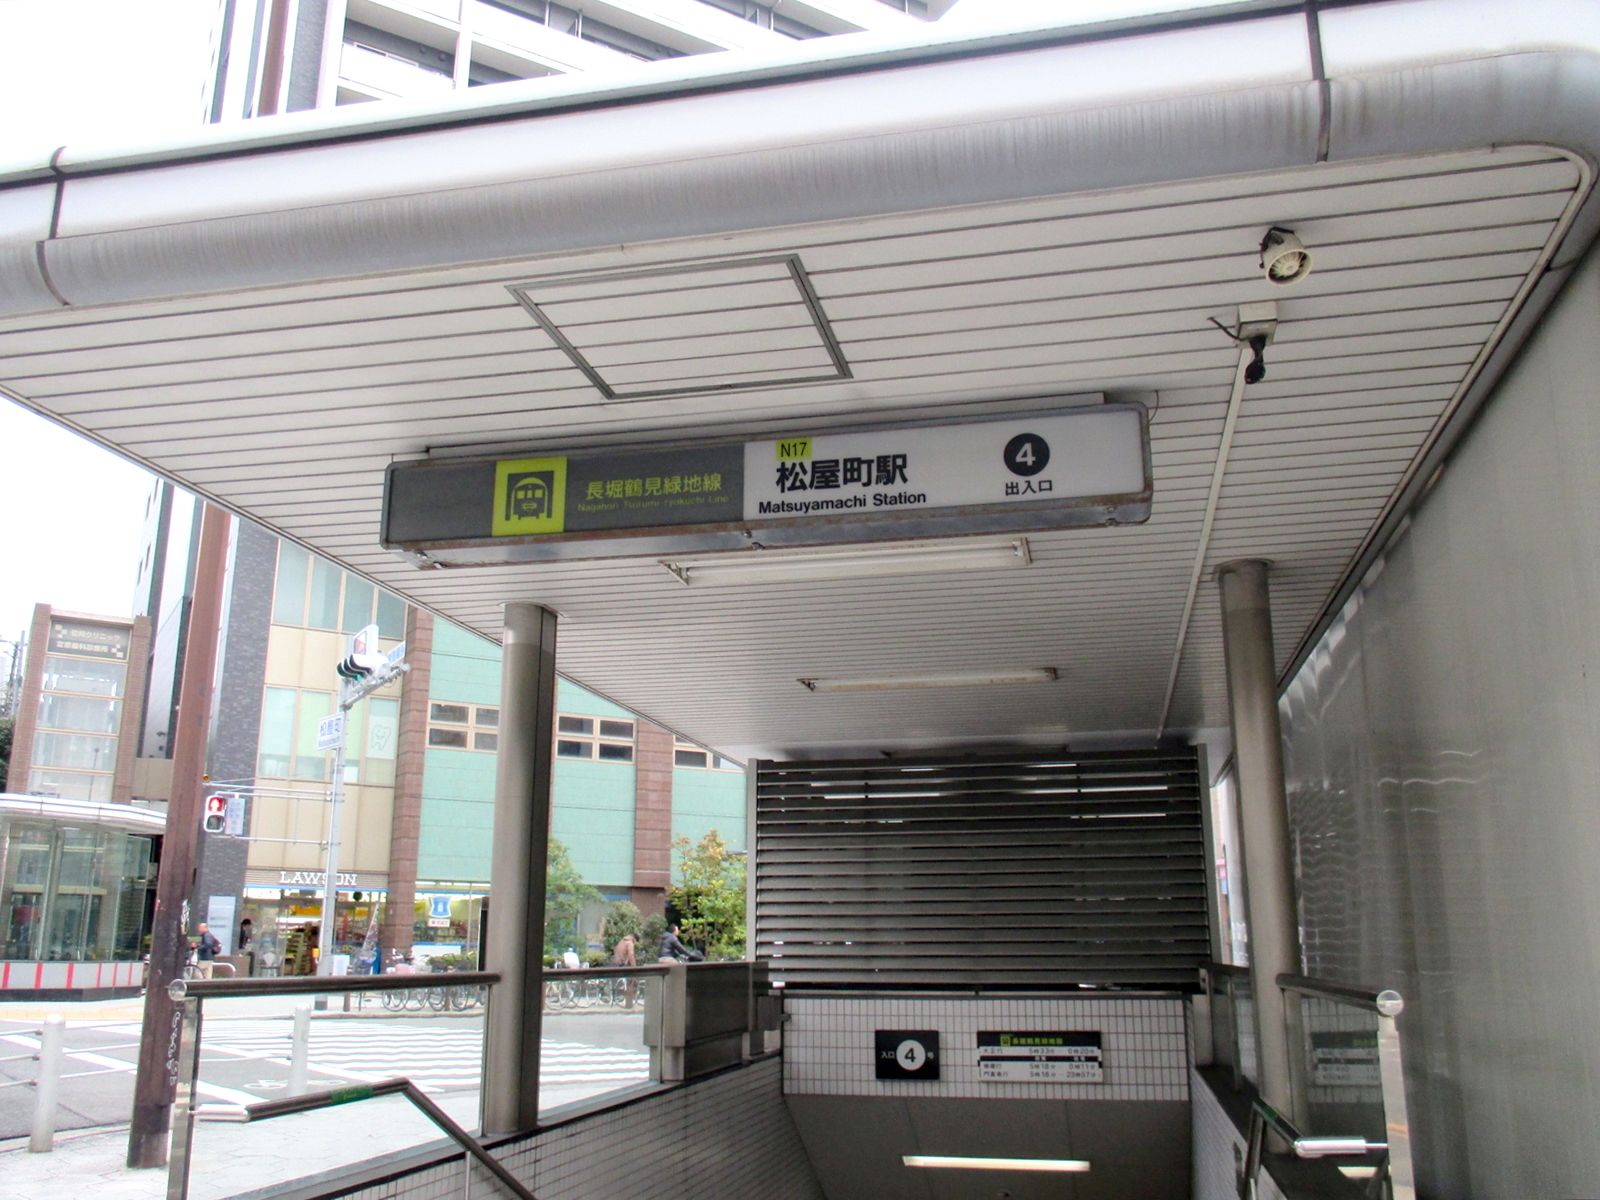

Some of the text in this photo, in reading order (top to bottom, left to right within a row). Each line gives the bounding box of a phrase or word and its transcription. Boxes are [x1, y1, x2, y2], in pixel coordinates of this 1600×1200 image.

[780, 441, 807, 458] N17
[1014, 442, 1037, 467] 4
[775, 453, 908, 493] 松屋町駅
[585, 472, 723, 500] 長堀鶴見緑地線
[1004, 479, 1053, 497] 出入口
[758, 490, 927, 515] Matsuyamachi Station
[904, 1047, 916, 1063] 4
